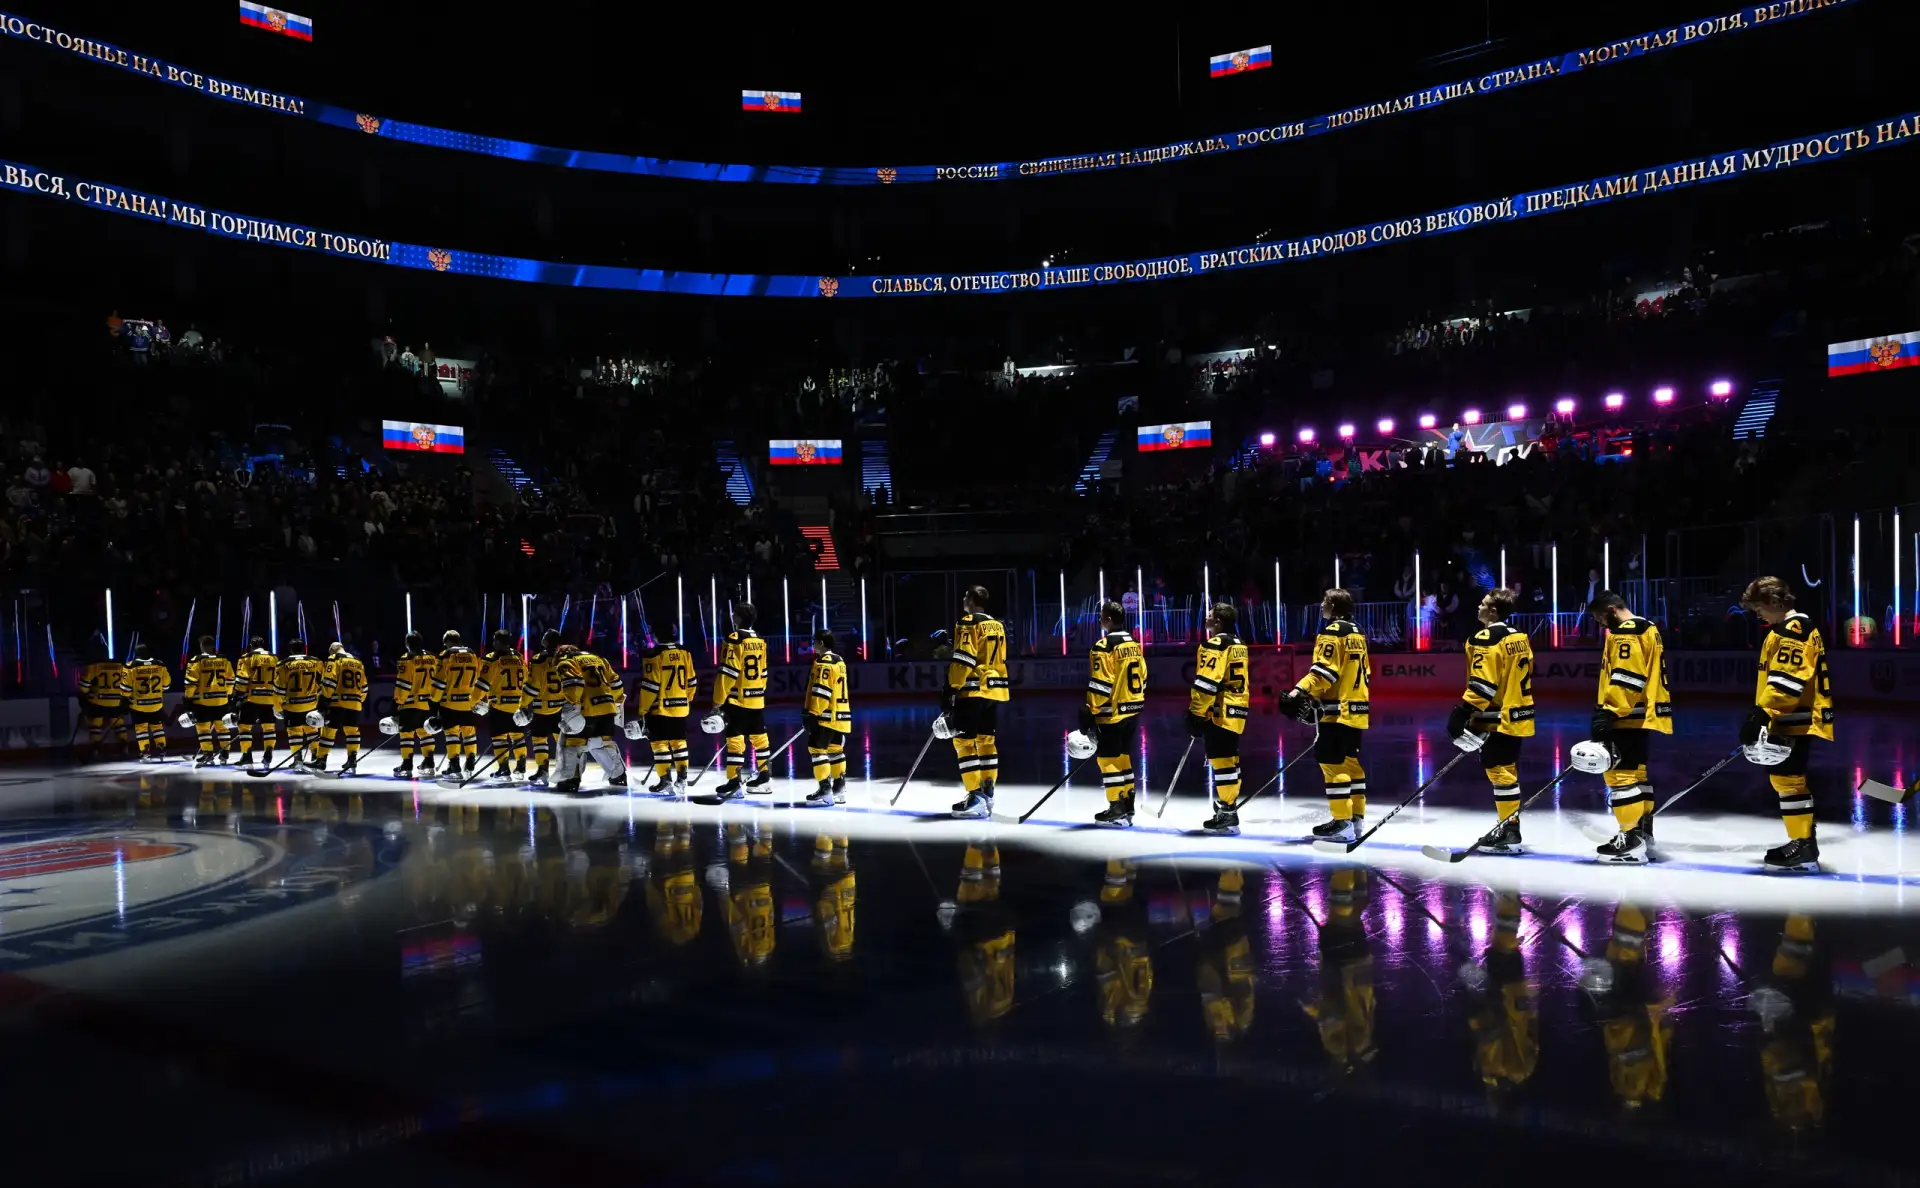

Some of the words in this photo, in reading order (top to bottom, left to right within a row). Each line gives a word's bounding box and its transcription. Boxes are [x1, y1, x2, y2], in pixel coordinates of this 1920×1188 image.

[1578, 28, 1678, 66] МОГУЧАЯ
[1684, 12, 1748, 41] ВОЛЯ,
[133, 55, 162, 77] НА
[167, 65, 204, 90] ВСЕ
[208, 78, 304, 115] ВРЕМЕНА!
[934, 165, 998, 180] РОССИЯ
[1019, 153, 1116, 176] СВЯЩЕННАЯ
[1237, 122, 1305, 146] РОССИЯ
[1326, 95, 1415, 128] ЛЮБИМАЯ
[1419, 80, 1475, 106] НАША
[1479, 60, 1560, 91] СТРАНА.
[0, 164, 70, 199] ВЬСЯ,
[75, 182, 166, 219] СТРАНА!
[172, 203, 206, 228] МЫ
[211, 212, 317, 247] ГОРДИМСЯ
[321, 233, 390, 260] ТОБОЙ!
[872, 277, 947, 293] СЛАВЬСЯ,
[950, 271, 1040, 291] ОТЕЧЕСТВО
[1044, 268, 1090, 286] НАШЕ
[1093, 257, 1193, 281] СВОБОДНОЕ,
[1200, 244, 1284, 270] БРАТСКИХ
[1287, 230, 1367, 258] НАРОДОВ
[1370, 218, 1422, 243] СОЮЗ
[1425, 197, 1518, 232] ВЕКОВОЙ,
[1526, 174, 1639, 213] ПРЕДКАМИ
[1643, 155, 1736, 194] ДАННАЯ
[1741, 129, 1870, 171] МУДРОСТЬ
[1200, 655, 1217, 670] 54
[1473, 654, 1483, 669] 2
[1619, 643, 1630, 659] 8
[1777, 646, 1803, 666] 66
[202, 669, 226, 688] 75
[288, 671, 315, 692] 17
[449, 666, 477, 688] 77
[661, 665, 687, 691] 70
[816, 667, 829, 680] 16
[1127, 661, 1140, 694] 6
[1229, 662, 1246, 693] 5
[1381, 664, 1436, 677] БАНК
[1518, 657, 1532, 696] 2
[136, 674, 161, 694] 32
[836, 676, 848, 704] 1
